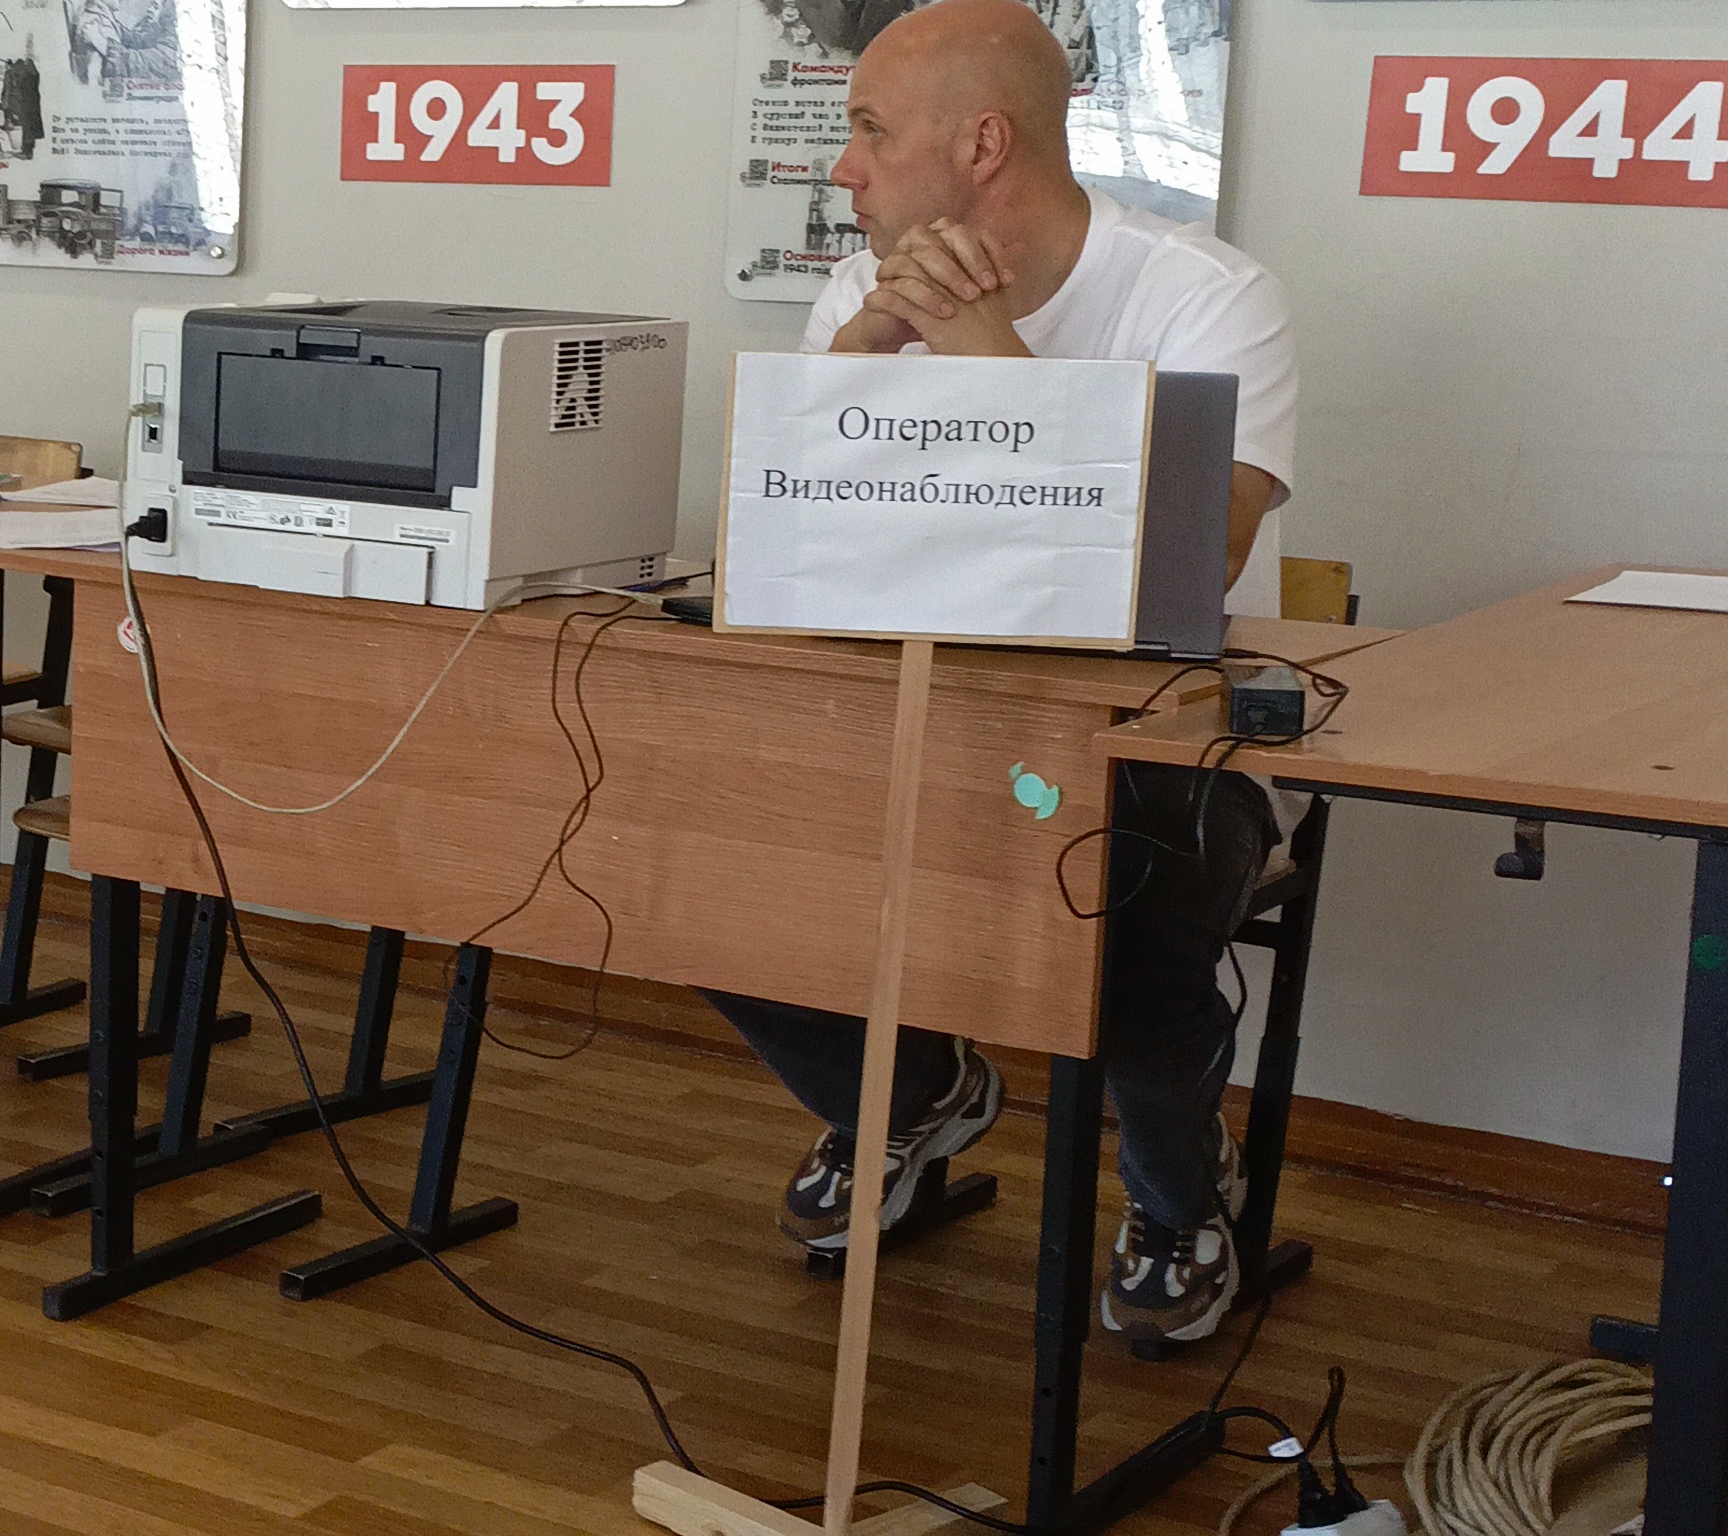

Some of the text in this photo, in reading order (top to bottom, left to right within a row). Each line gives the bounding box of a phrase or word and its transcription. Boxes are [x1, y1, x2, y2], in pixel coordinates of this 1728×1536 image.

[366, 79, 586, 165] 1943
[1398, 75, 1728, 182] 1944
[838, 406, 1036, 453] Оператор
[762, 468, 1105, 509] Видеонаблюдения
